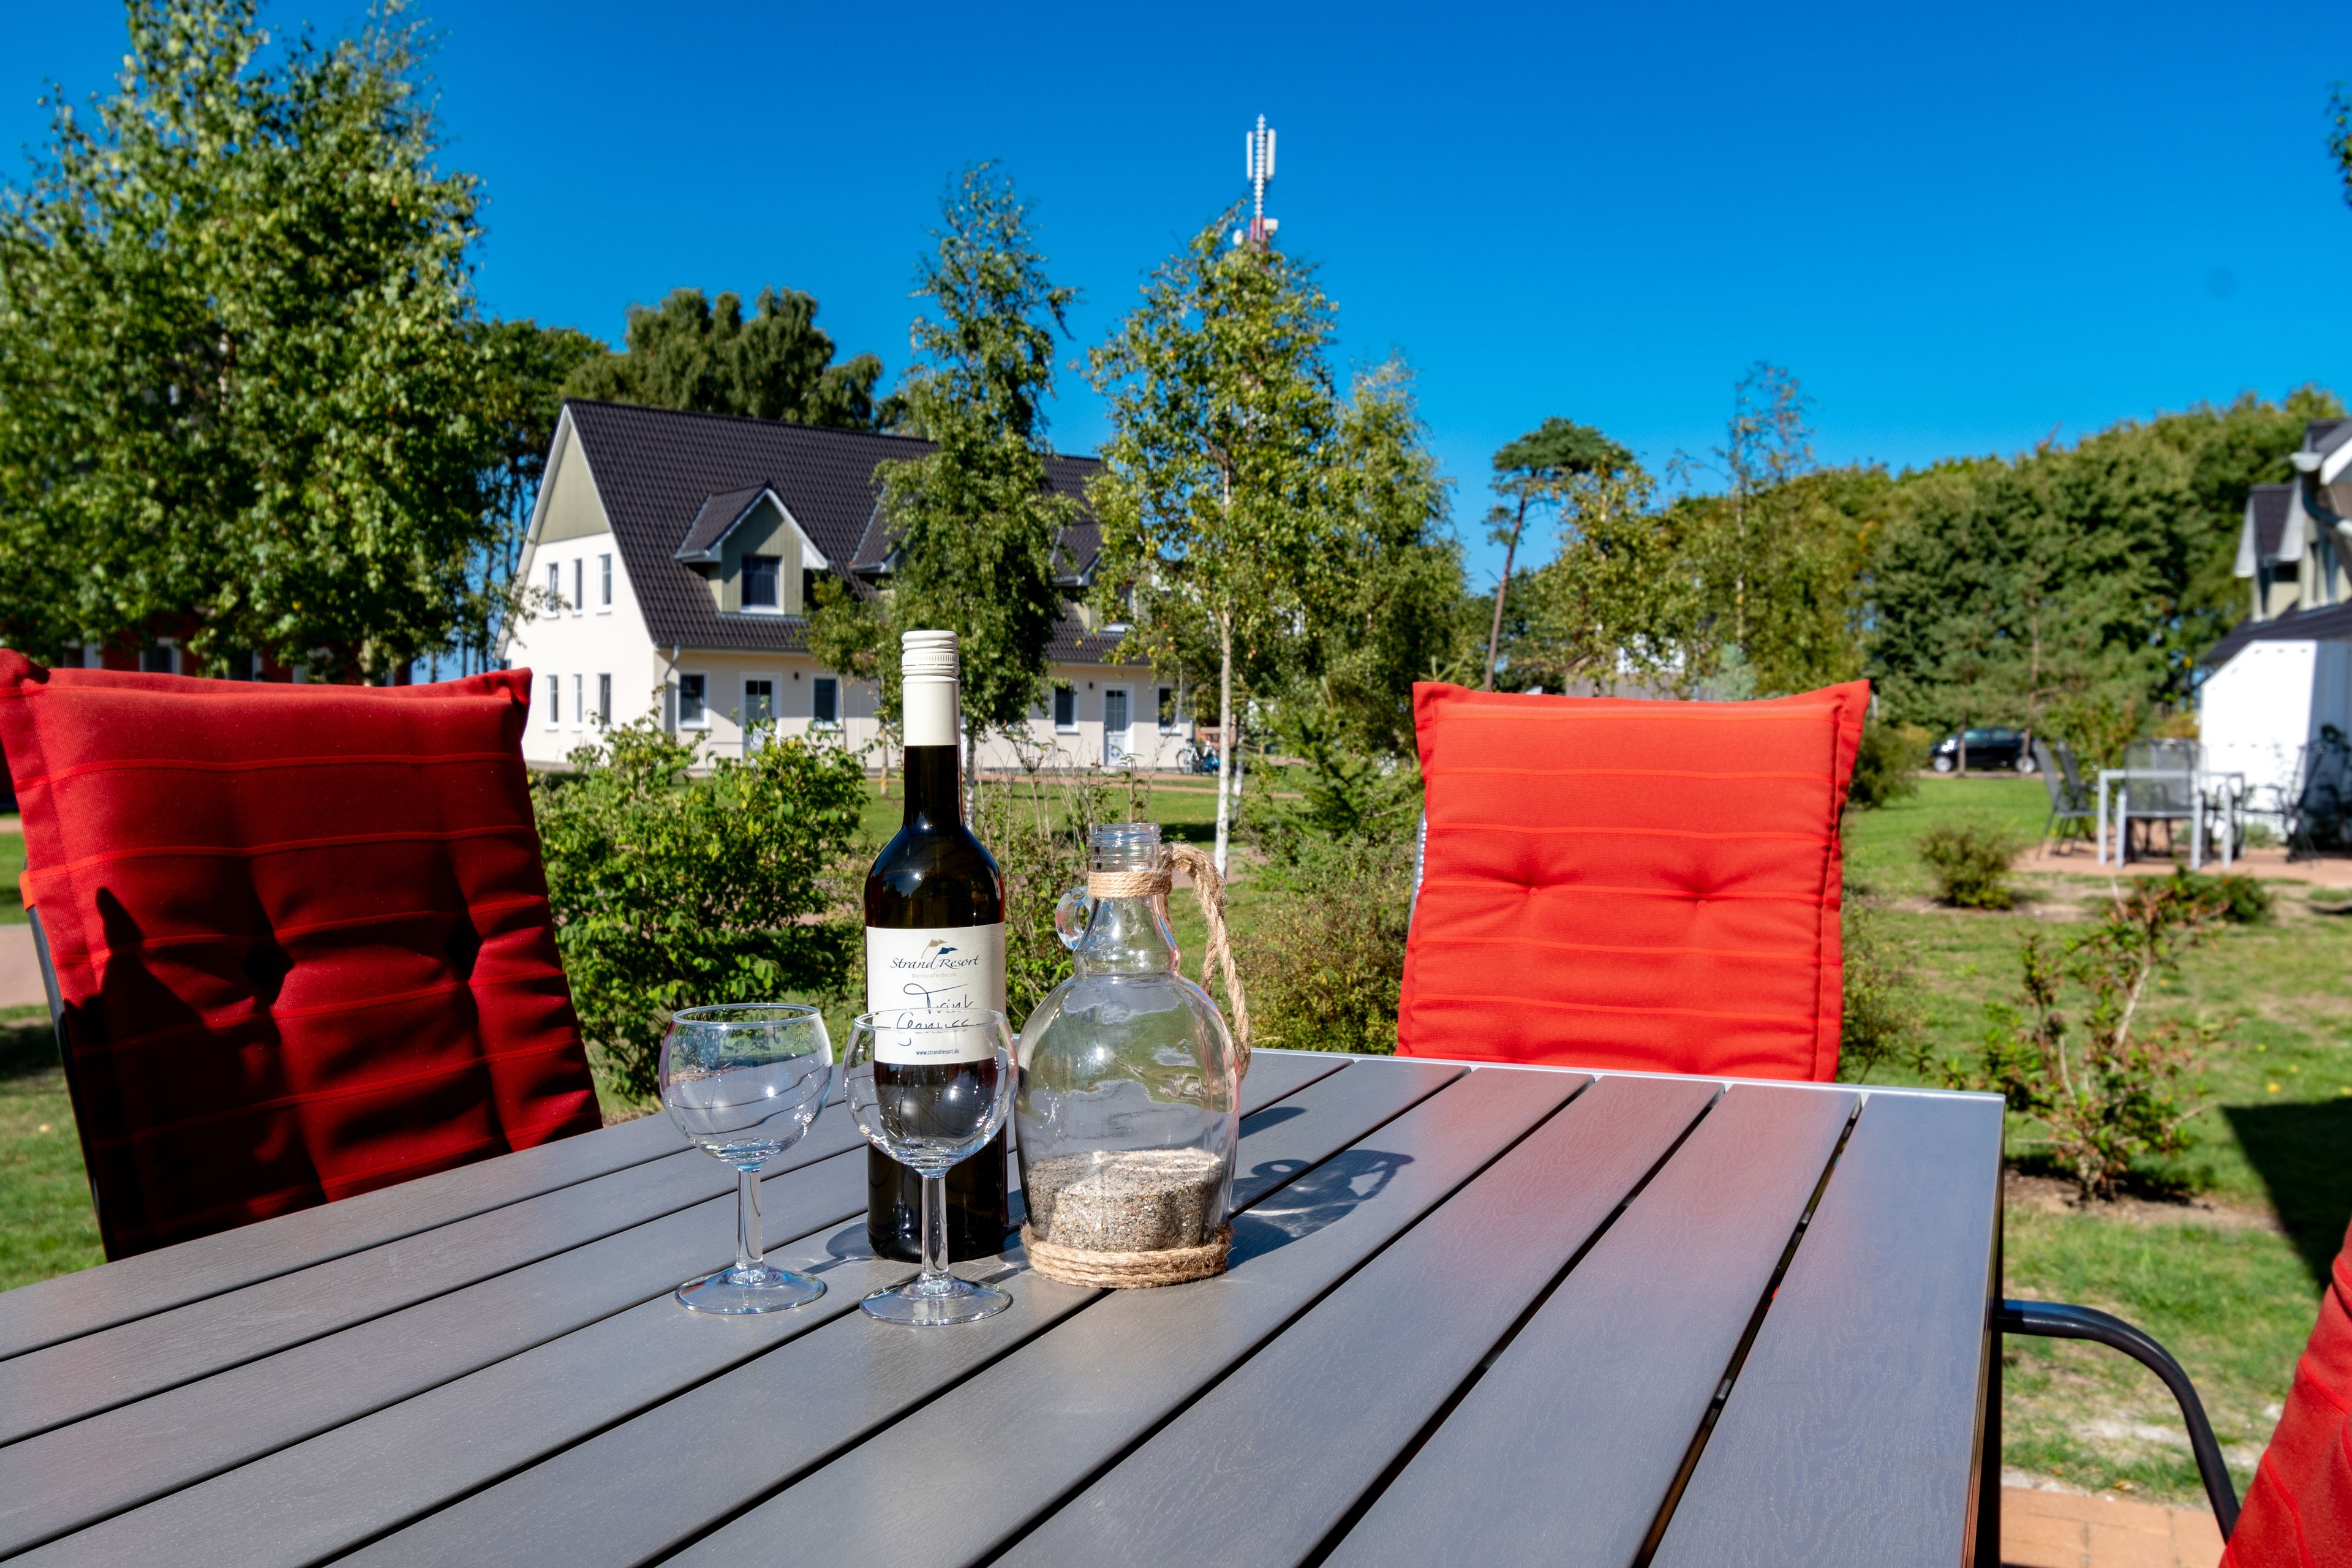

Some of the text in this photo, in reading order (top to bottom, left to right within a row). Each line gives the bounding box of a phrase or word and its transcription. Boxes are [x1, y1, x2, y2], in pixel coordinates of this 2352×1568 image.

[890, 954, 981, 970] Strand Resort
[903, 983, 973, 1014] Trink
